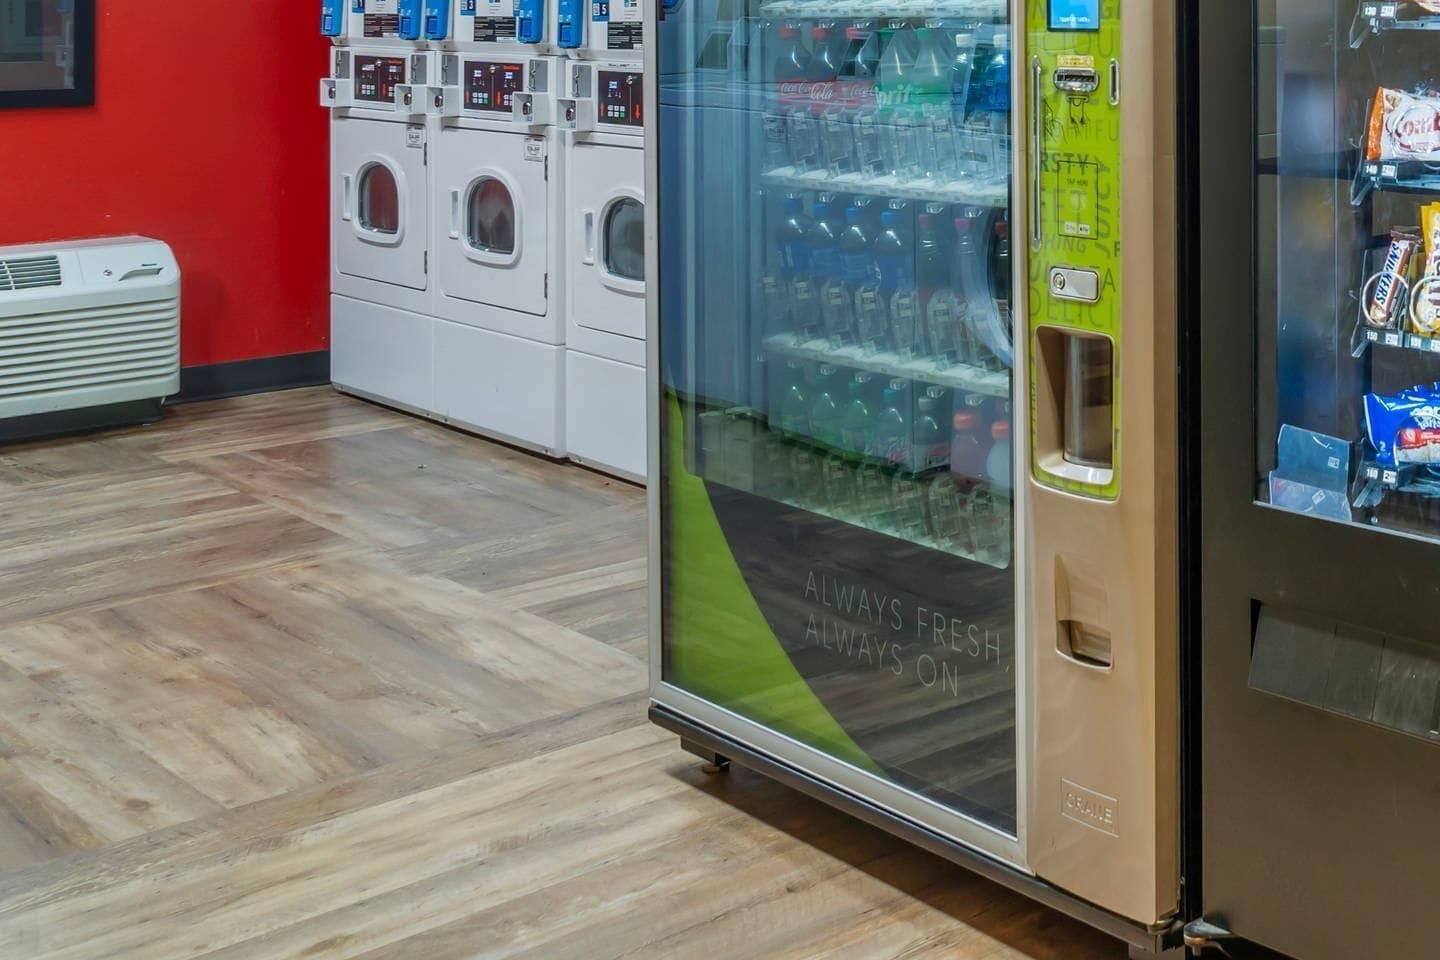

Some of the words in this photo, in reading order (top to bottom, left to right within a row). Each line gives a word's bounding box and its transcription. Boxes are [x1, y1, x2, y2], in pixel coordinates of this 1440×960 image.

[468, 0, 475, 8] 3
[600, 5, 608, 15] 5
[804, 570, 903, 631] ALWAYS
[804, 613, 903, 676] ALWAYS
[916, 653, 959, 697] ON
